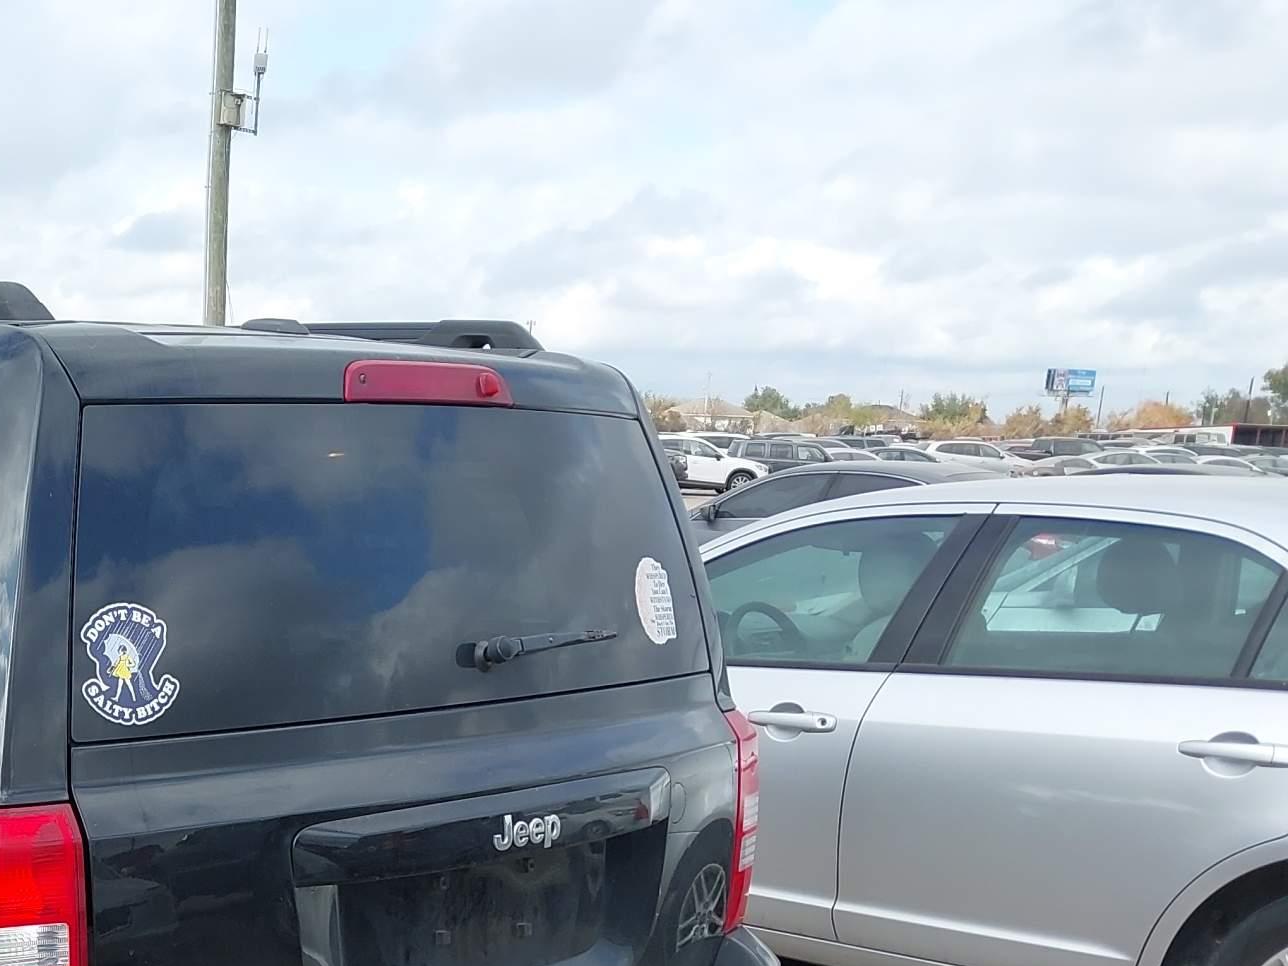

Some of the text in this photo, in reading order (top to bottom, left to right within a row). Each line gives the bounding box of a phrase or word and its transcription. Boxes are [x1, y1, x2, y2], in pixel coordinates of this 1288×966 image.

[87, 609, 162, 642] DON'T BE A
[88, 680, 175, 719] SALTY BITCH
[493, 814, 561, 851] Jeep
